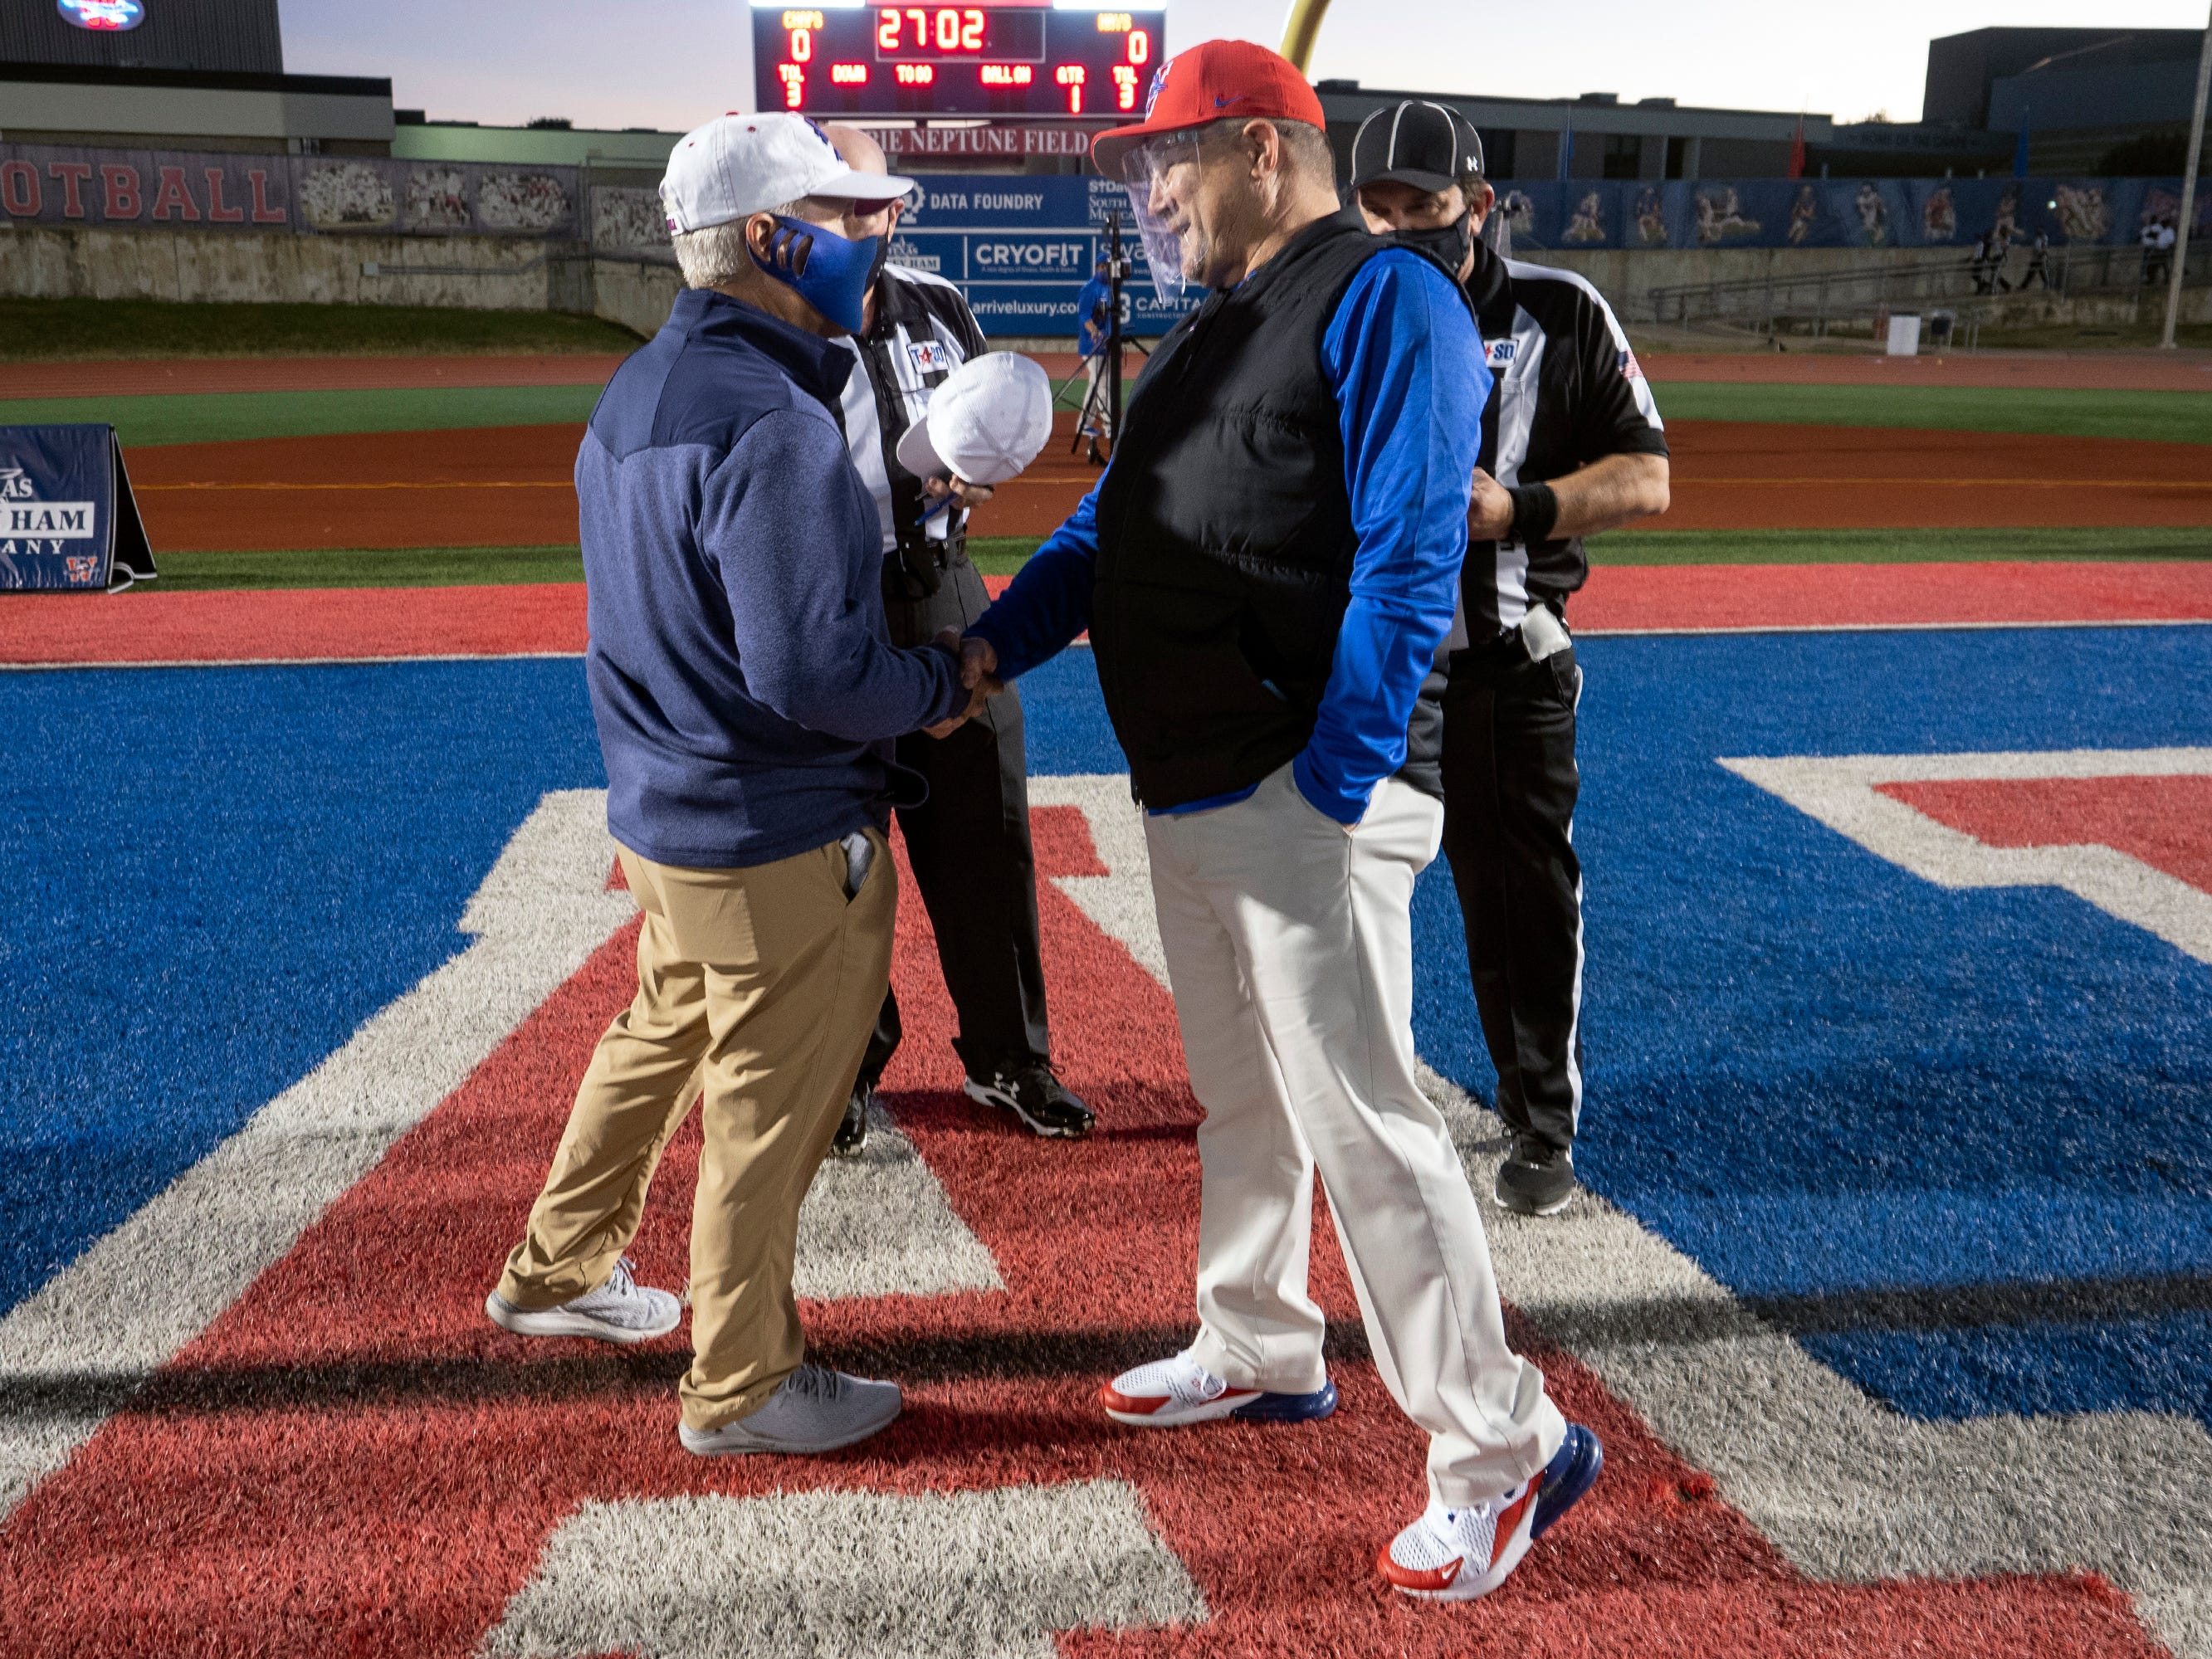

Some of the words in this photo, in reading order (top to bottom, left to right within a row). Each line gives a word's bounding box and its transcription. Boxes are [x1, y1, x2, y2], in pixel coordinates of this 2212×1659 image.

[791, 28, 811, 62] 0
[1128, 31, 1148, 64] 0
[832, 64, 867, 84] DOWN
[1056, 66, 1085, 85] QTR
[786, 82, 801, 108] 3
[1071, 85, 1081, 113] 1
[1120, 83, 1134, 109] 3
[910, 129, 1018, 153] NEPTUNE
[1024, 129, 1088, 154] FIELD
[930, 193, 969, 210] DATA
[974, 193, 1043, 211] FOUNDRY
[975, 243, 1084, 266] CRYOFIT
[1135, 296, 1204, 312] CAPITA
[11, 510, 85, 530] HAM
